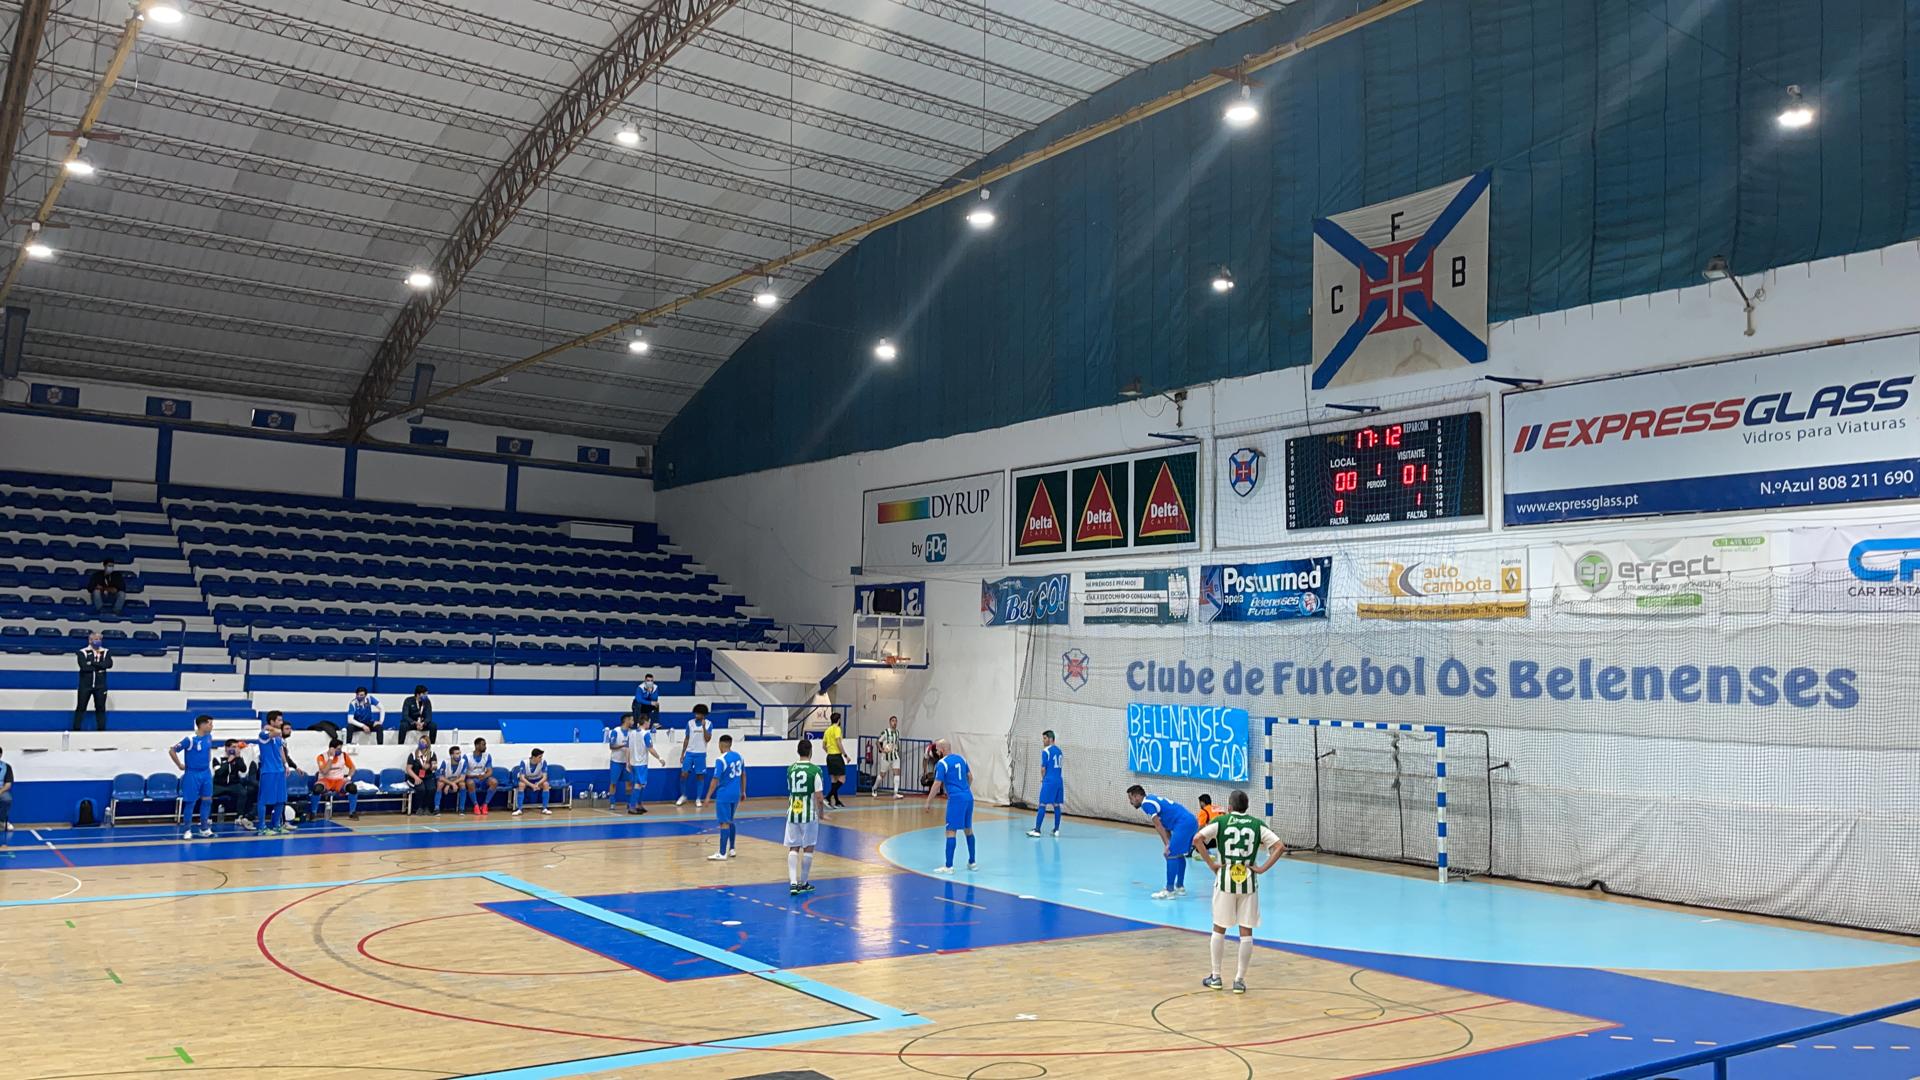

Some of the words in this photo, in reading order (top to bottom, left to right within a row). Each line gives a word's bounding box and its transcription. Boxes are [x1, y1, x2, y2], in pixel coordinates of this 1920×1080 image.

[1390, 211, 1404, 242] F
[1452, 256, 1466, 288] B
[1331, 285, 1344, 314] C
[1541, 375, 1914, 450] EXPRESSGLASS
[1356, 425, 1402, 449] 17:12
[1743, 430, 1791, 445] Vidros
[1797, 425, 1832, 442] para
[1837, 417, 1906, 435] Viaturas
[1330, 457, 1357, 468] LOCAL
[1397, 448, 1426, 461] VISITANTE
[1335, 471, 1357, 491] 00
[1403, 464, 1428, 485] 01
[1818, 475, 1847, 490] 808
[1851, 473, 1879, 488] 211
[1884, 470, 1914, 486] 690
[931, 488, 990, 519] DYRUP
[1151, 502, 1178, 518] Delta
[1335, 499, 1344, 513] 0
[1516, 493, 1639, 514] www.expressglass.pt
[1030, 515, 1052, 530] Delta
[1087, 509, 1111, 525] Delta
[1329, 516, 1349, 526] FALTAS
[1365, 513, 1390, 523] JOGADOR
[1406, 510, 1428, 519] FALTAS
[911, 542, 923, 557] by
[926, 536, 946, 560] PPG
[1223, 565, 1321, 593] Posturmed
[1424, 563, 1458, 579] auto
[1618, 555, 1720, 583] effect
[1423, 576, 1491, 593] cambota
[1848, 586, 1876, 597] CAR
[1224, 594, 1244, 606] apoia
[1126, 658, 1215, 695] Clube
[1223, 659, 1265, 696] de
[1274, 657, 1425, 697] Futebol
[1436, 657, 1497, 699] Os
[1509, 657, 1860, 710] Belenenses
[1129, 703, 1234, 743] BELENENSES
[1128, 736, 1162, 772] NÃO
[1169, 740, 1203, 775] TEM
[729, 760, 742, 778] 33
[790, 770, 808, 793] 12
[1223, 826, 1255, 857] 23
